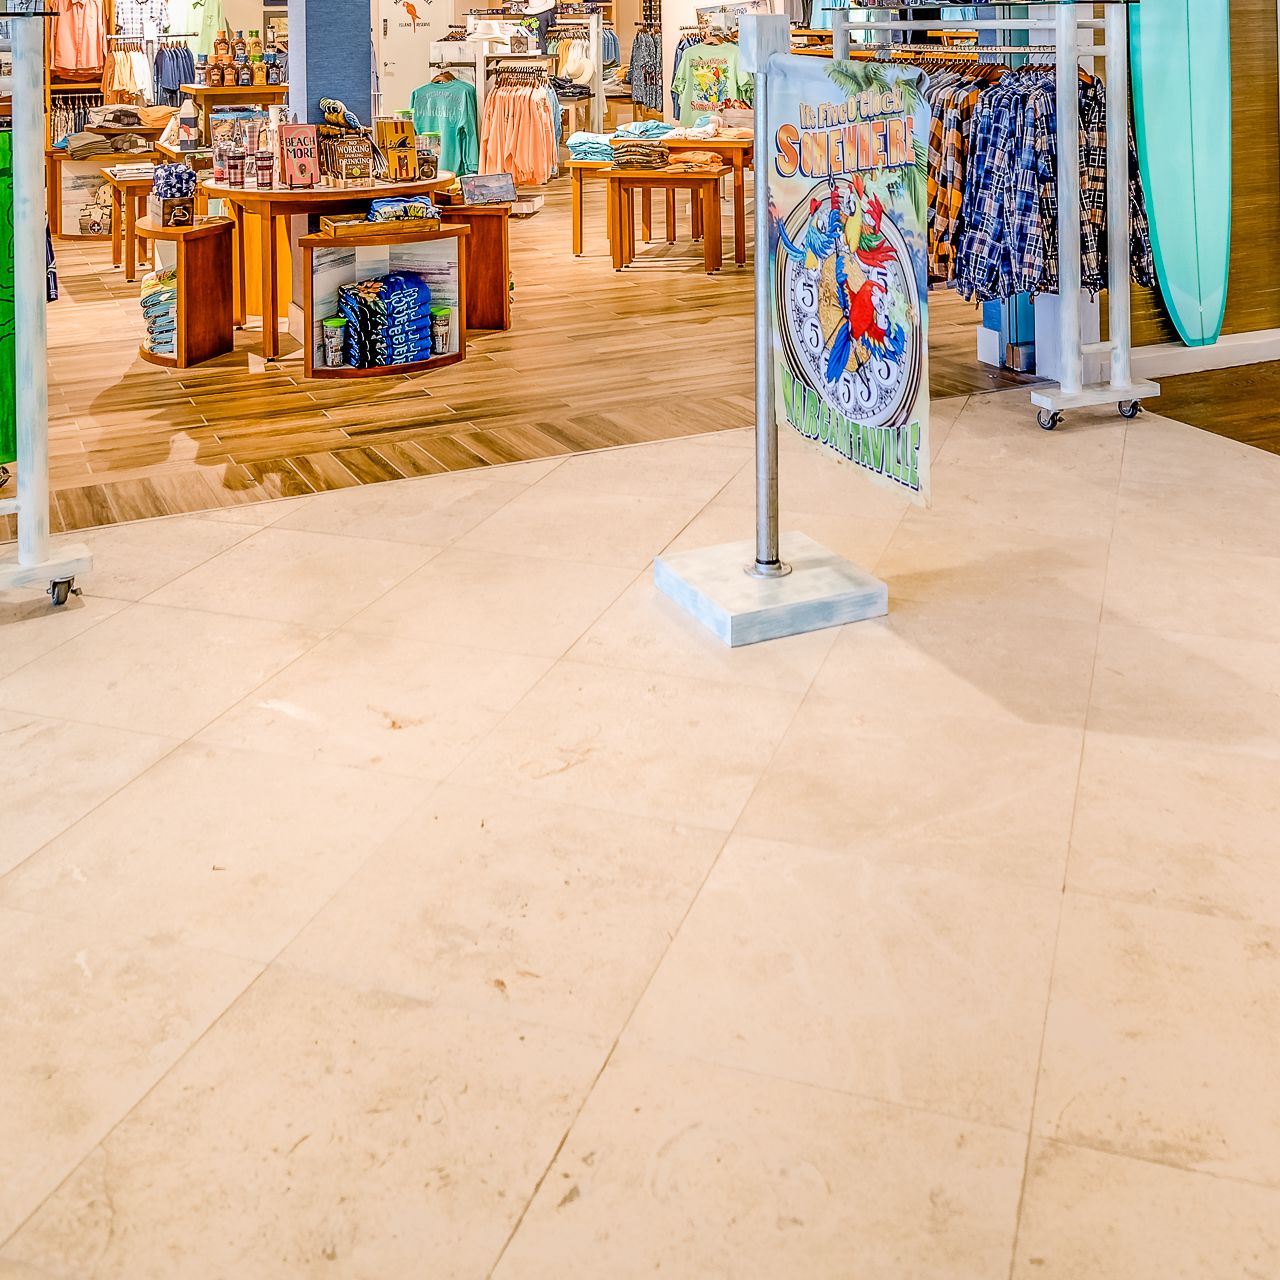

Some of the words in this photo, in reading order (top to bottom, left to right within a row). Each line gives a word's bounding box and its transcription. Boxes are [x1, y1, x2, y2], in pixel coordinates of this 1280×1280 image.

[285, 136, 317, 148] BEACH
[776, 115, 916, 178] SOMEWHERE
[286, 148, 317, 159] MORE
[337, 145, 370, 154] WORKING
